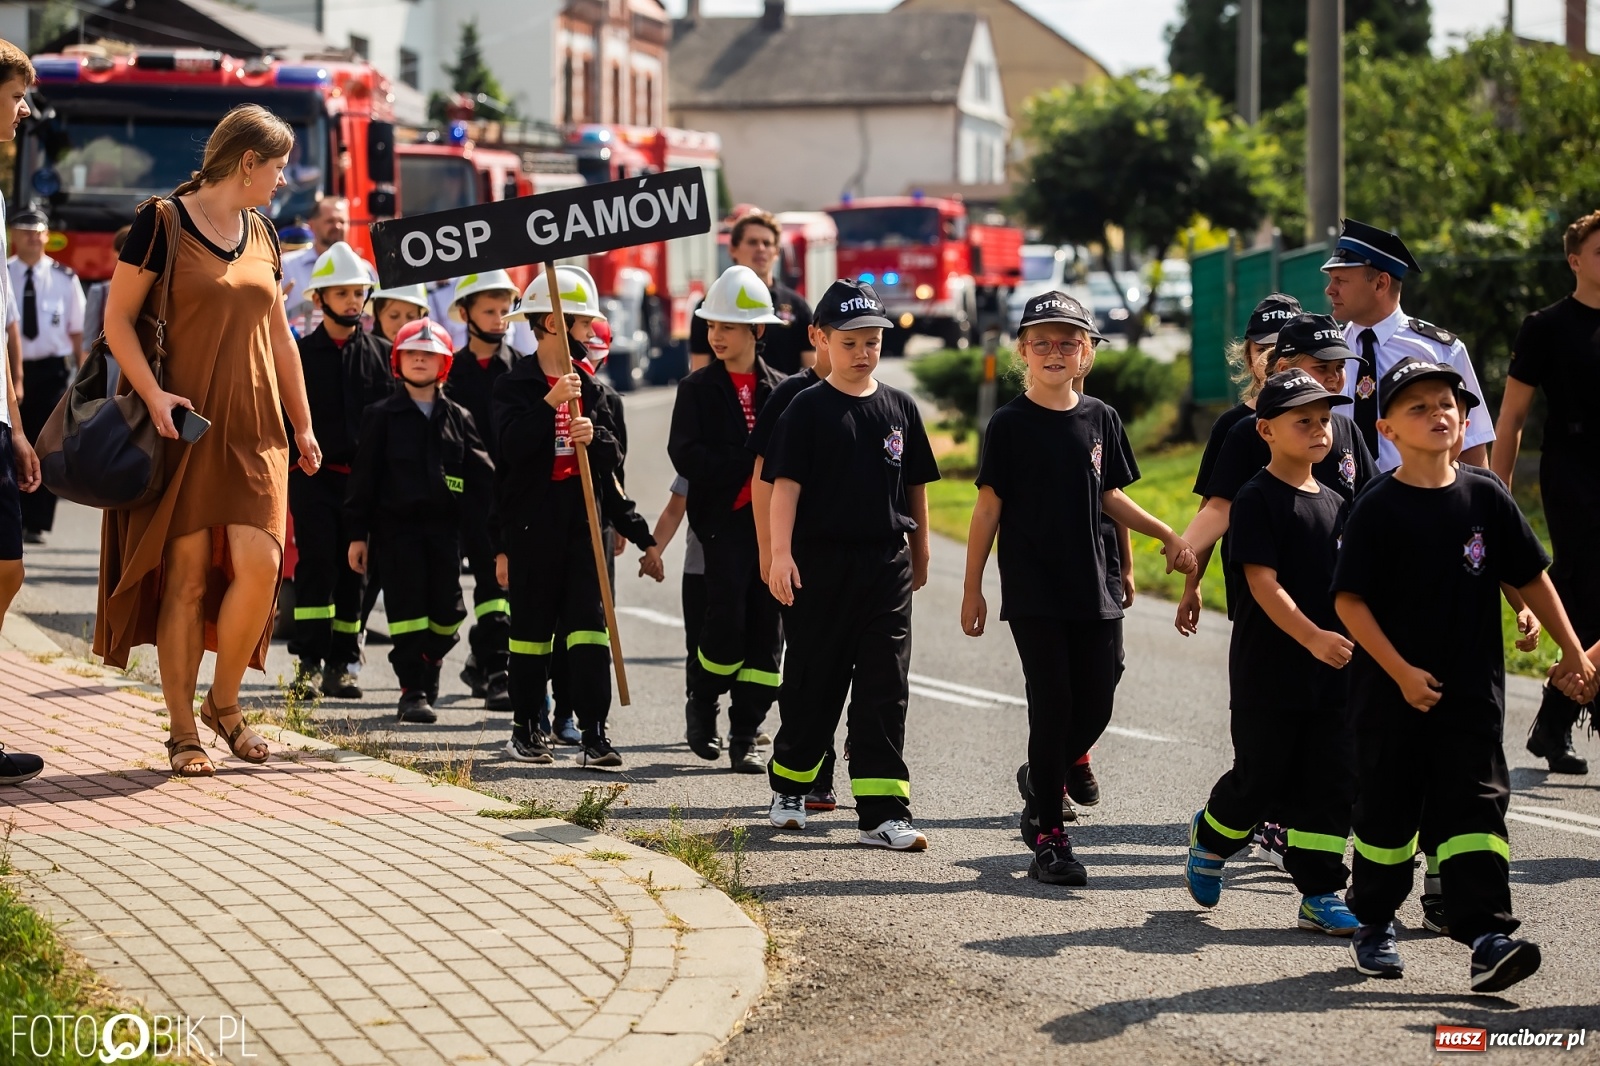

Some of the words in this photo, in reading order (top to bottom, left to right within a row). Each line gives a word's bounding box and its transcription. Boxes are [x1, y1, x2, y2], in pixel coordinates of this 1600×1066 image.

[400, 220, 492, 267] OSP
[526, 178, 699, 246] GAMÓW
[1262, 310, 1297, 322] STRA
[1313, 329, 1346, 341] STRA
